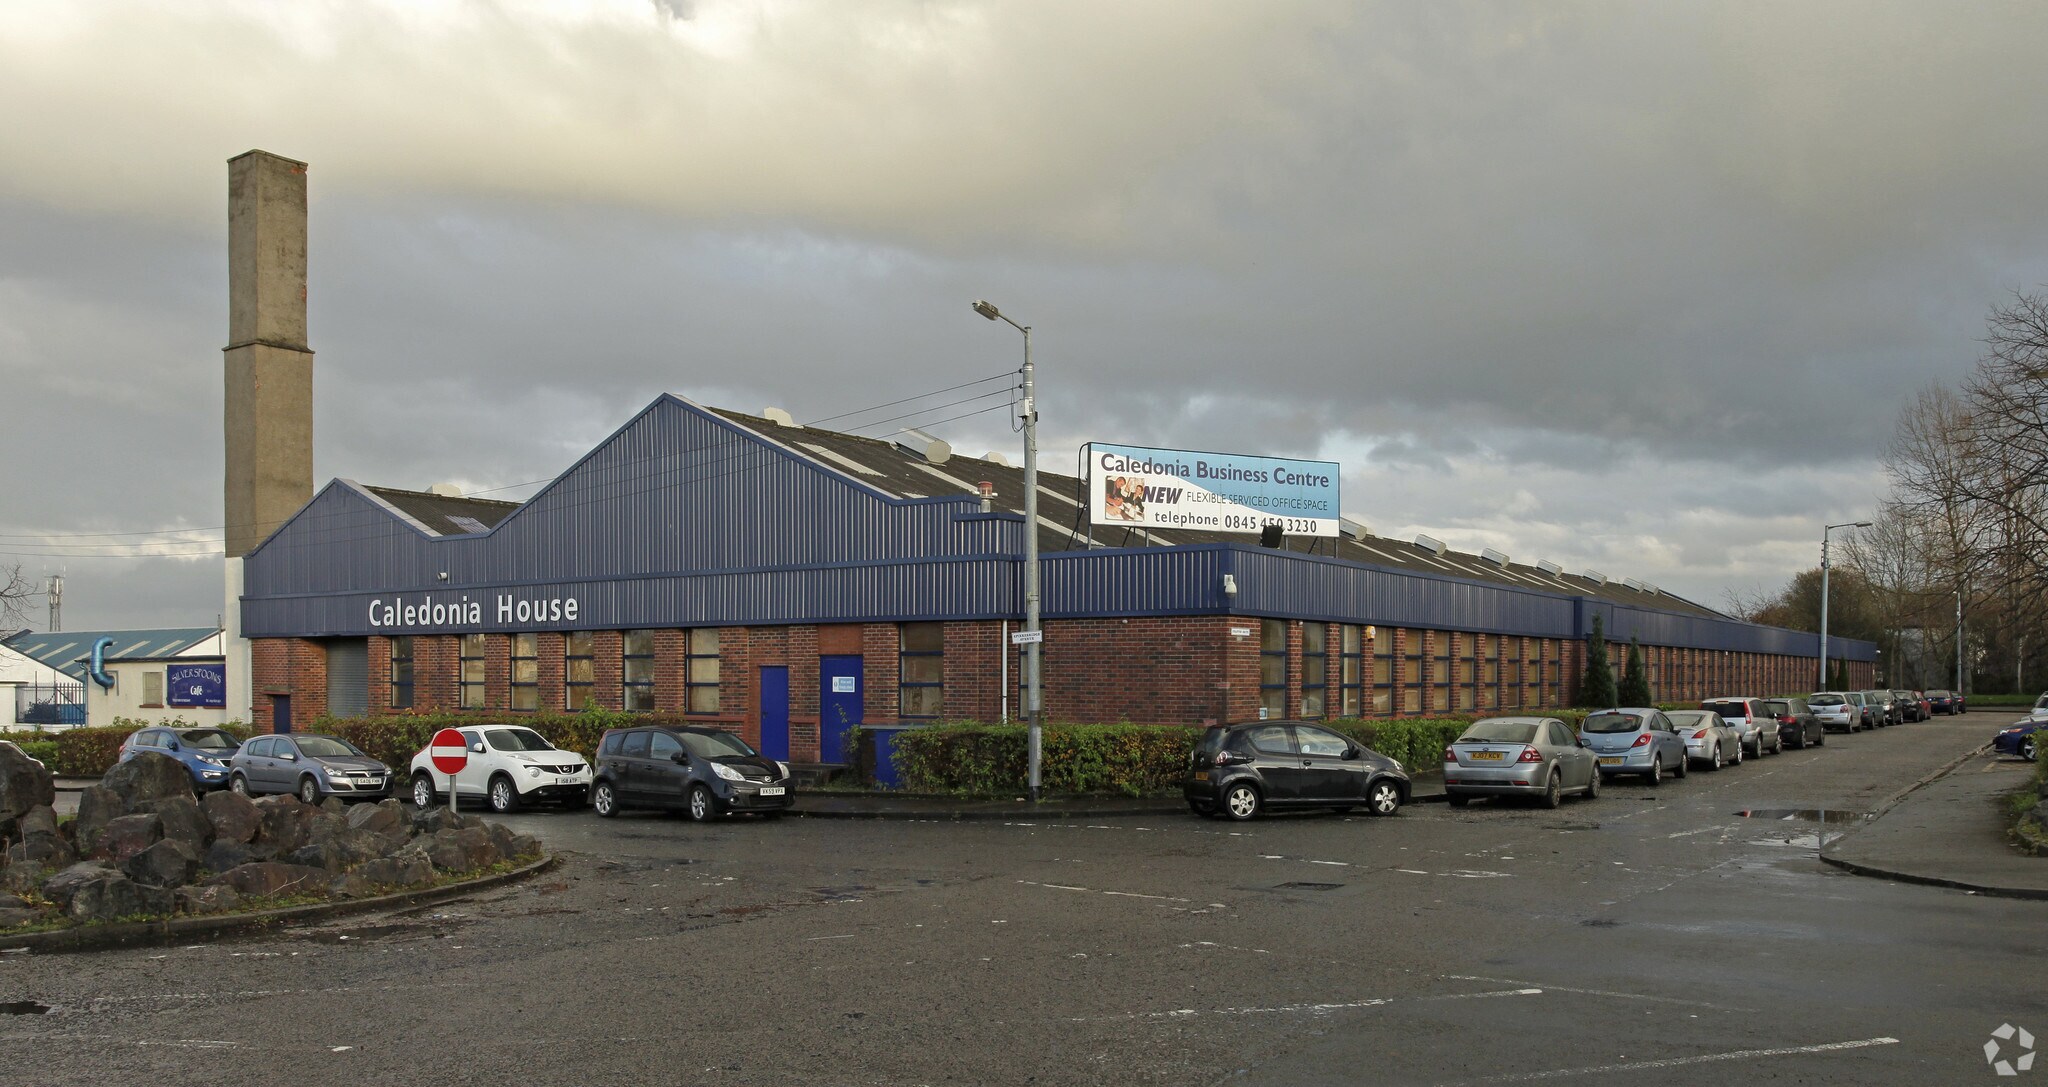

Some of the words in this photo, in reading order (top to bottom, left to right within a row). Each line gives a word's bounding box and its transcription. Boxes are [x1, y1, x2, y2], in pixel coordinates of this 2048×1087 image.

[1100, 453, 1191, 478] Caledonia
[1196, 460, 1269, 483] Business
[1273, 467, 1330, 488] Centre
[1142, 485, 1184, 505] NEW
[1186, 491, 1227, 505] FLEXIBLE
[1228, 493, 1270, 508] SERVICED
[1271, 497, 1302, 510] OFFICE
[1303, 500, 1328, 511] SPACE
[1154, 510, 1219, 528] telephone
[1224, 514, 1257, 530] 0845
[1286, 518, 1318, 533] 3230
[368, 595, 481, 627] Caledonia
[497, 594, 579, 623] House
[193, 668, 222, 685] SPOONS
